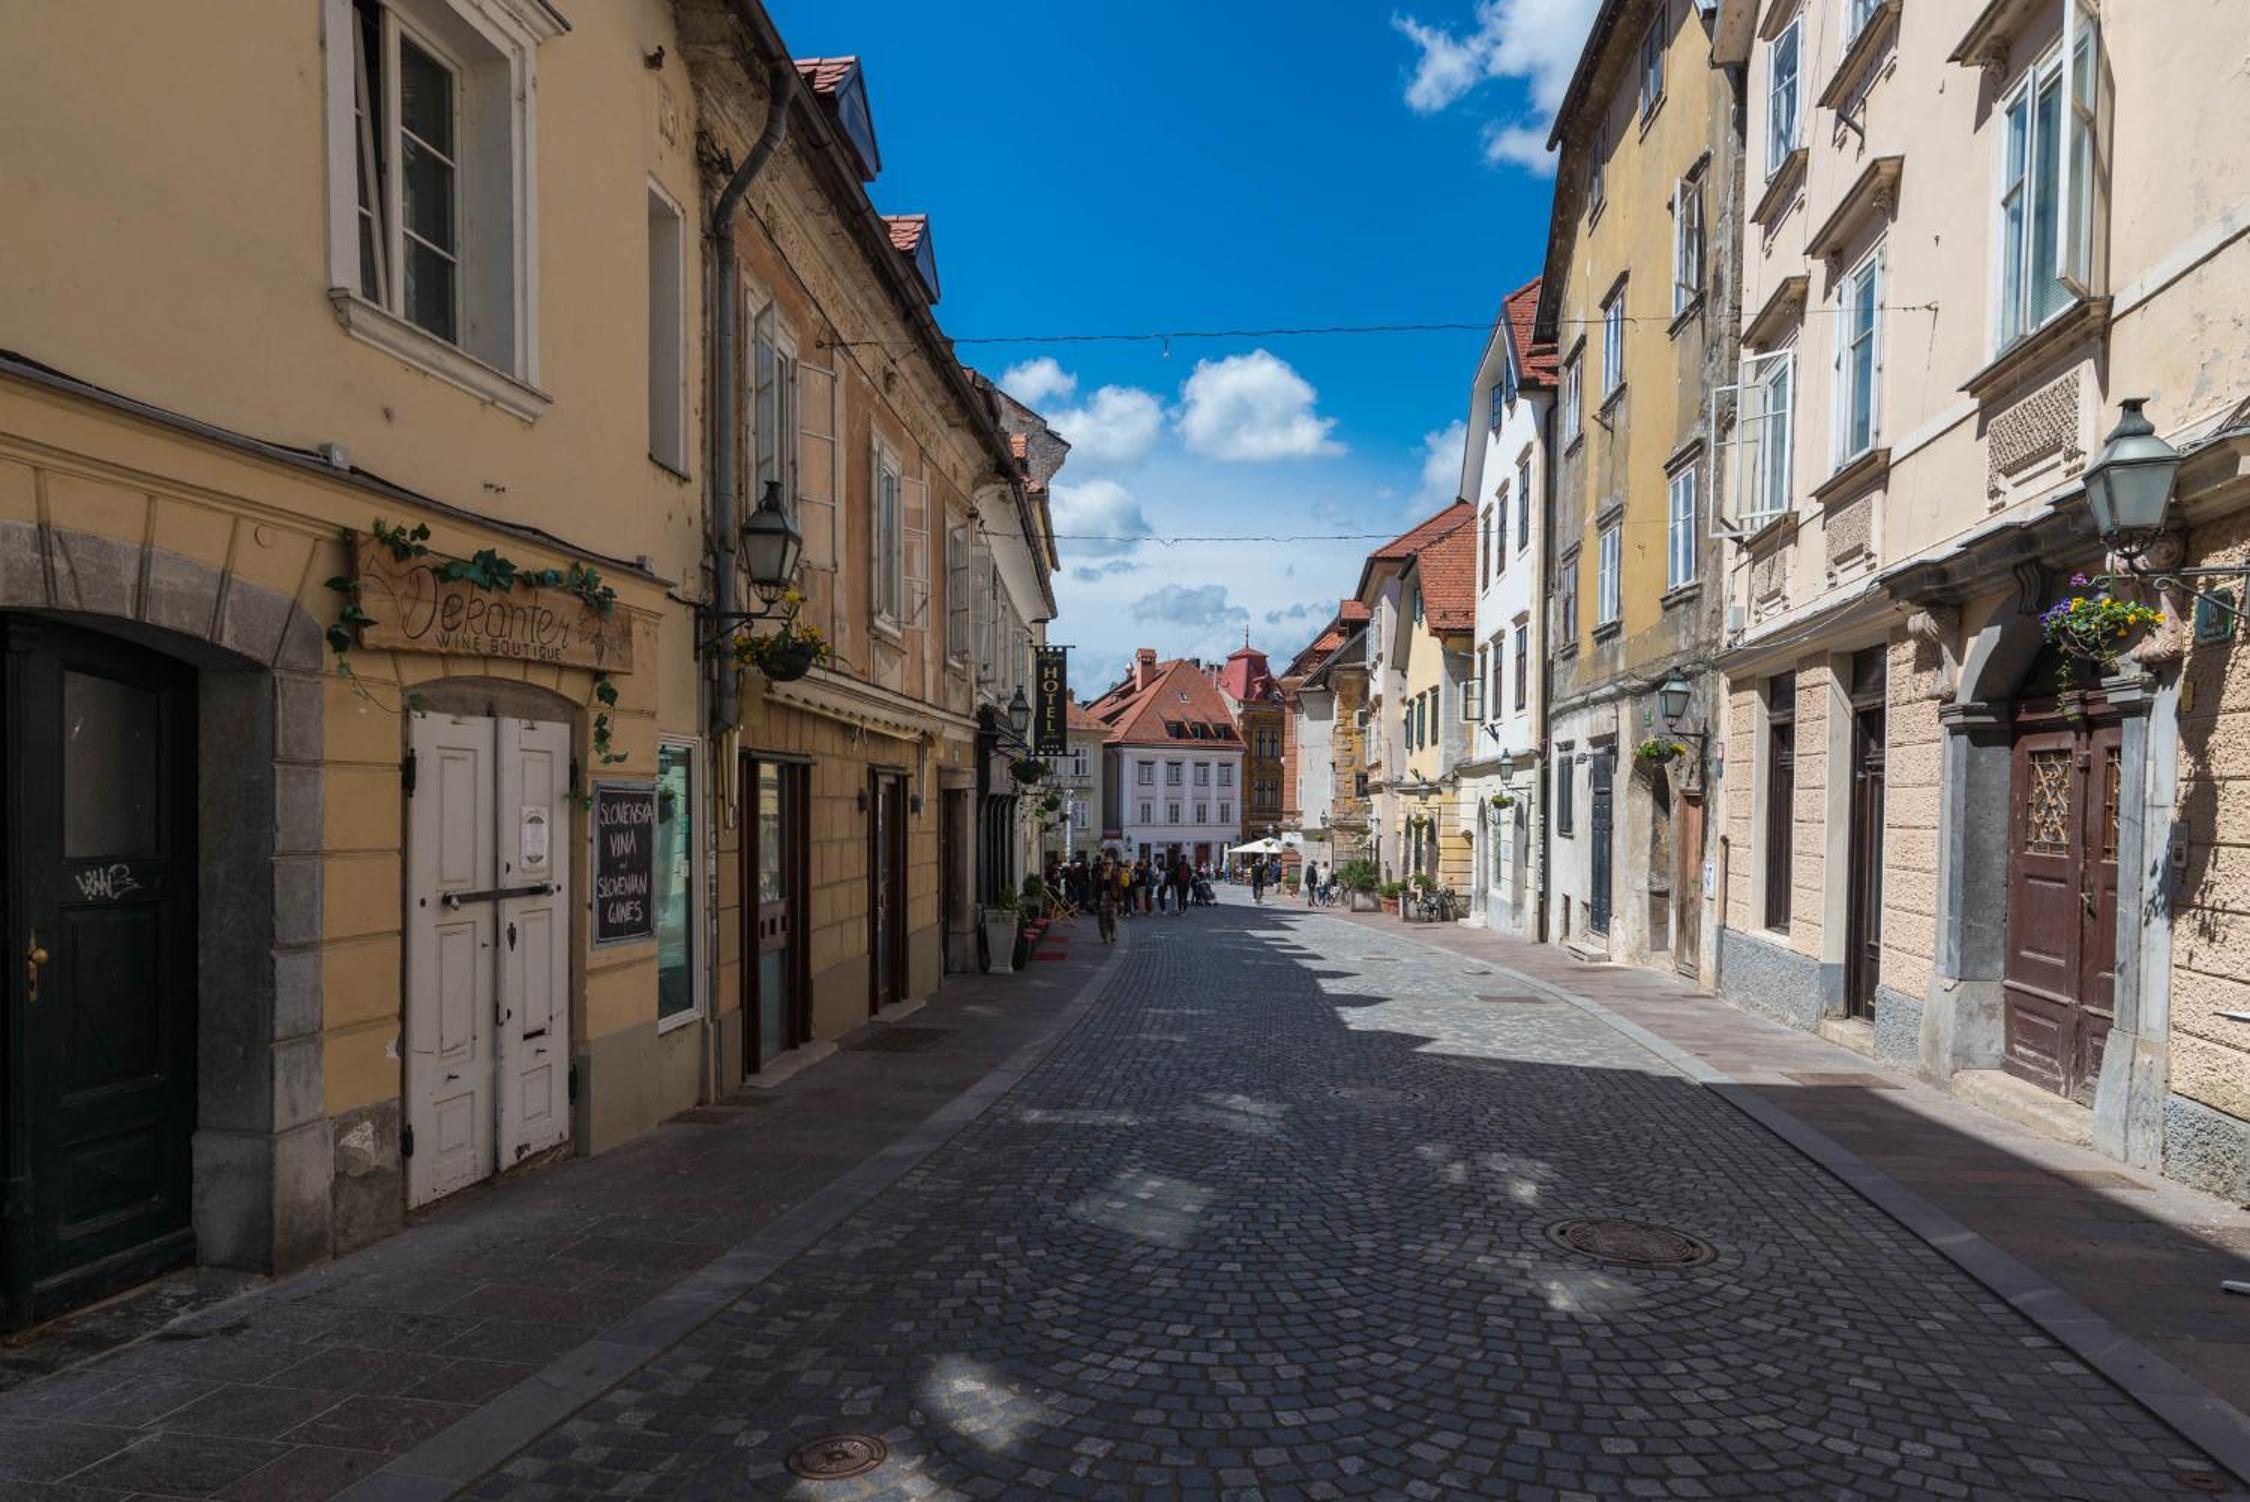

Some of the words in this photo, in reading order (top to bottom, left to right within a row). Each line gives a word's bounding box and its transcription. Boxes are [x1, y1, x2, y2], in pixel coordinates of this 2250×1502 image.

[435, 633, 481, 651] WINE
[492, 638, 562, 660] BOUTIQUE
[1043, 667, 1058, 731] HOTEL
[609, 829, 637, 858] VINA
